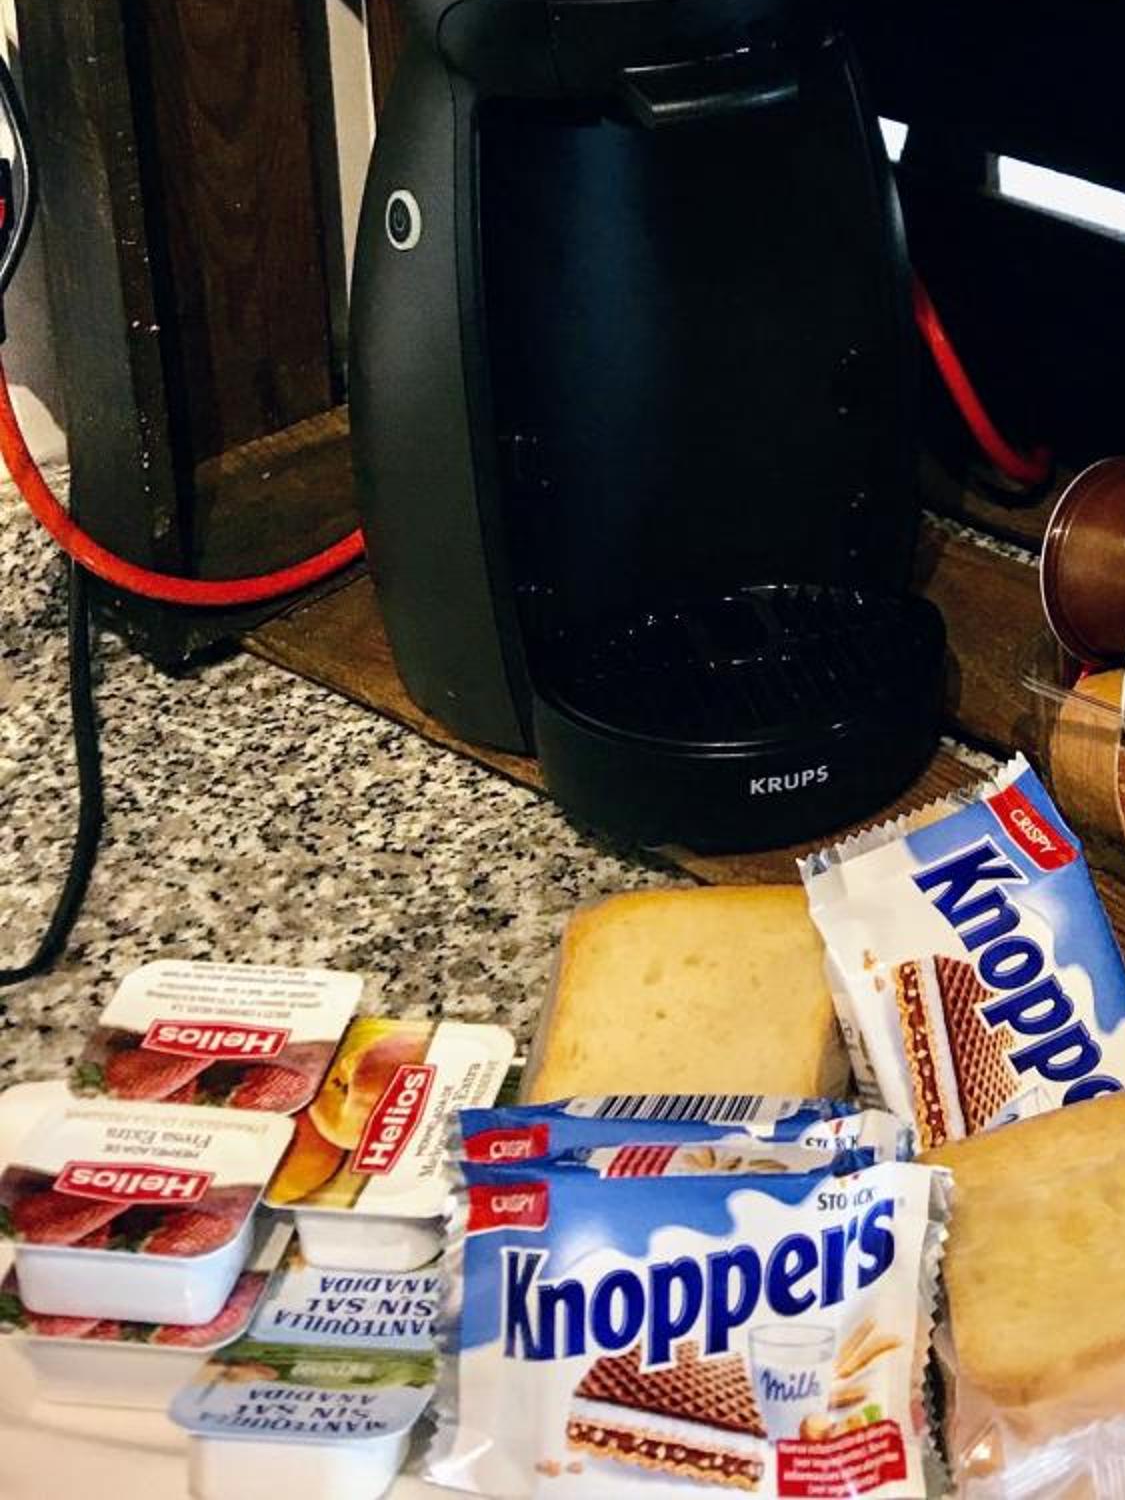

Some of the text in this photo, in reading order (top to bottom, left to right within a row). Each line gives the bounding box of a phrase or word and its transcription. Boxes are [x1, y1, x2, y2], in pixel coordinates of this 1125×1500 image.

[750, 765, 829, 795] KRUPS
[1009, 807, 1057, 854] CRISPY
[158, 1026, 278, 1054] Helios
[361, 1072, 427, 1167] Helios
[70, 1168, 200, 1198] Helios
[503, 1198, 897, 1367] Knoppers
[307, 1296, 434, 1318] SIN SAL
[309, 1406, 370, 1421] SIN
